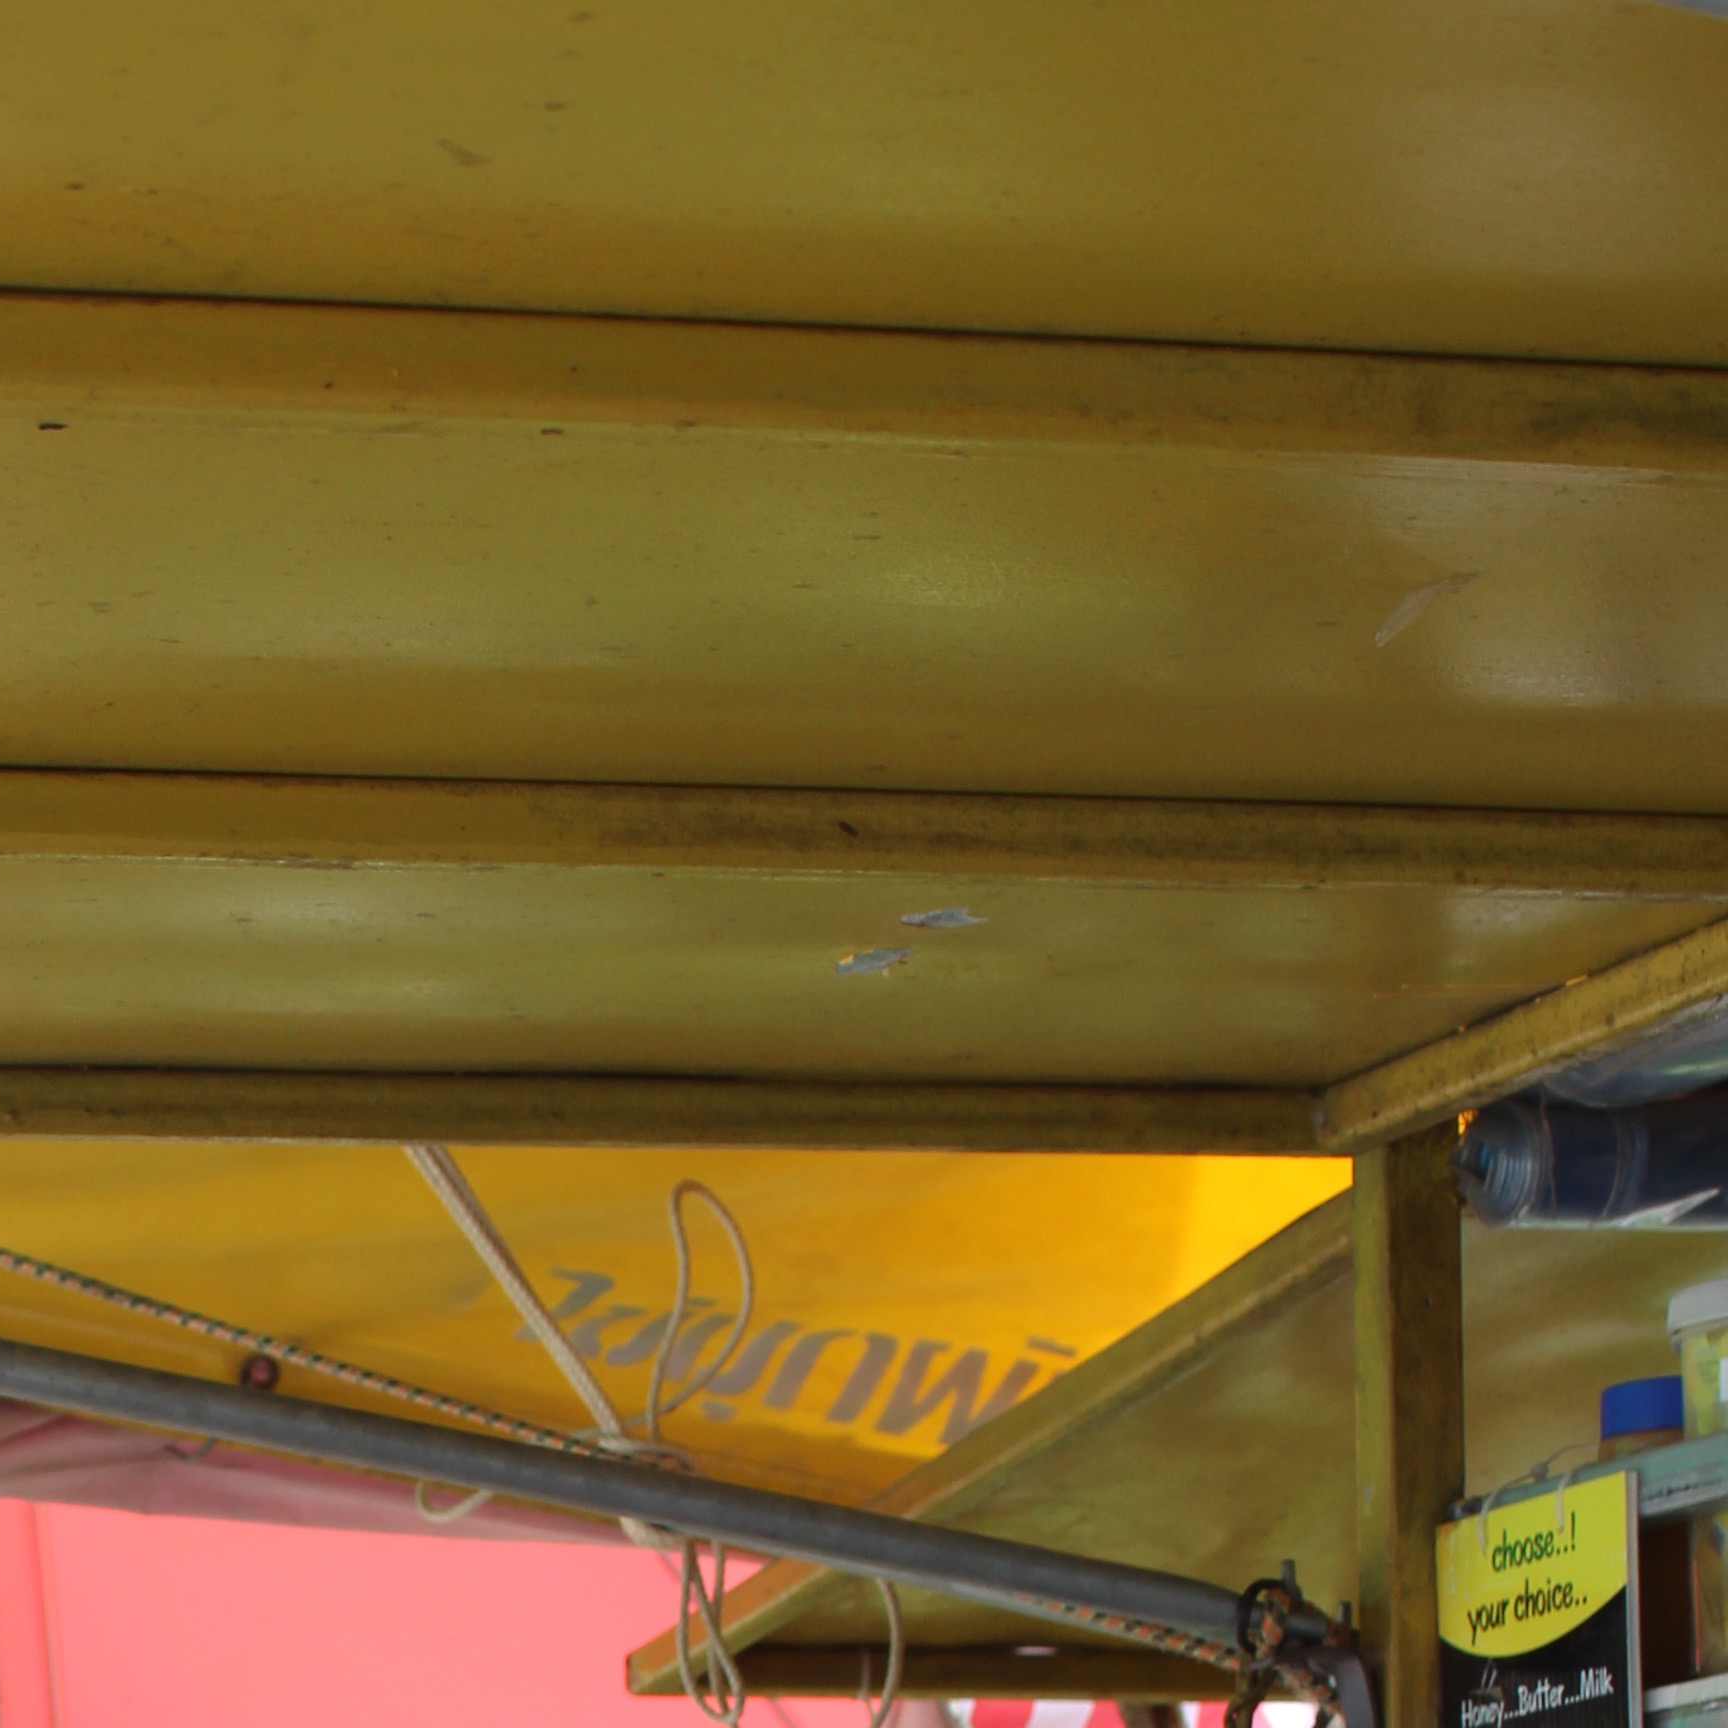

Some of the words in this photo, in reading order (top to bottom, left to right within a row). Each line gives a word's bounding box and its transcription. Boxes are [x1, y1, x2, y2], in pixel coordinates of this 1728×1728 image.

[1491, 1511, 1576, 1573] choose..!
[1467, 1598, 1510, 1646] your
[1513, 1576, 1588, 1622] choice..
